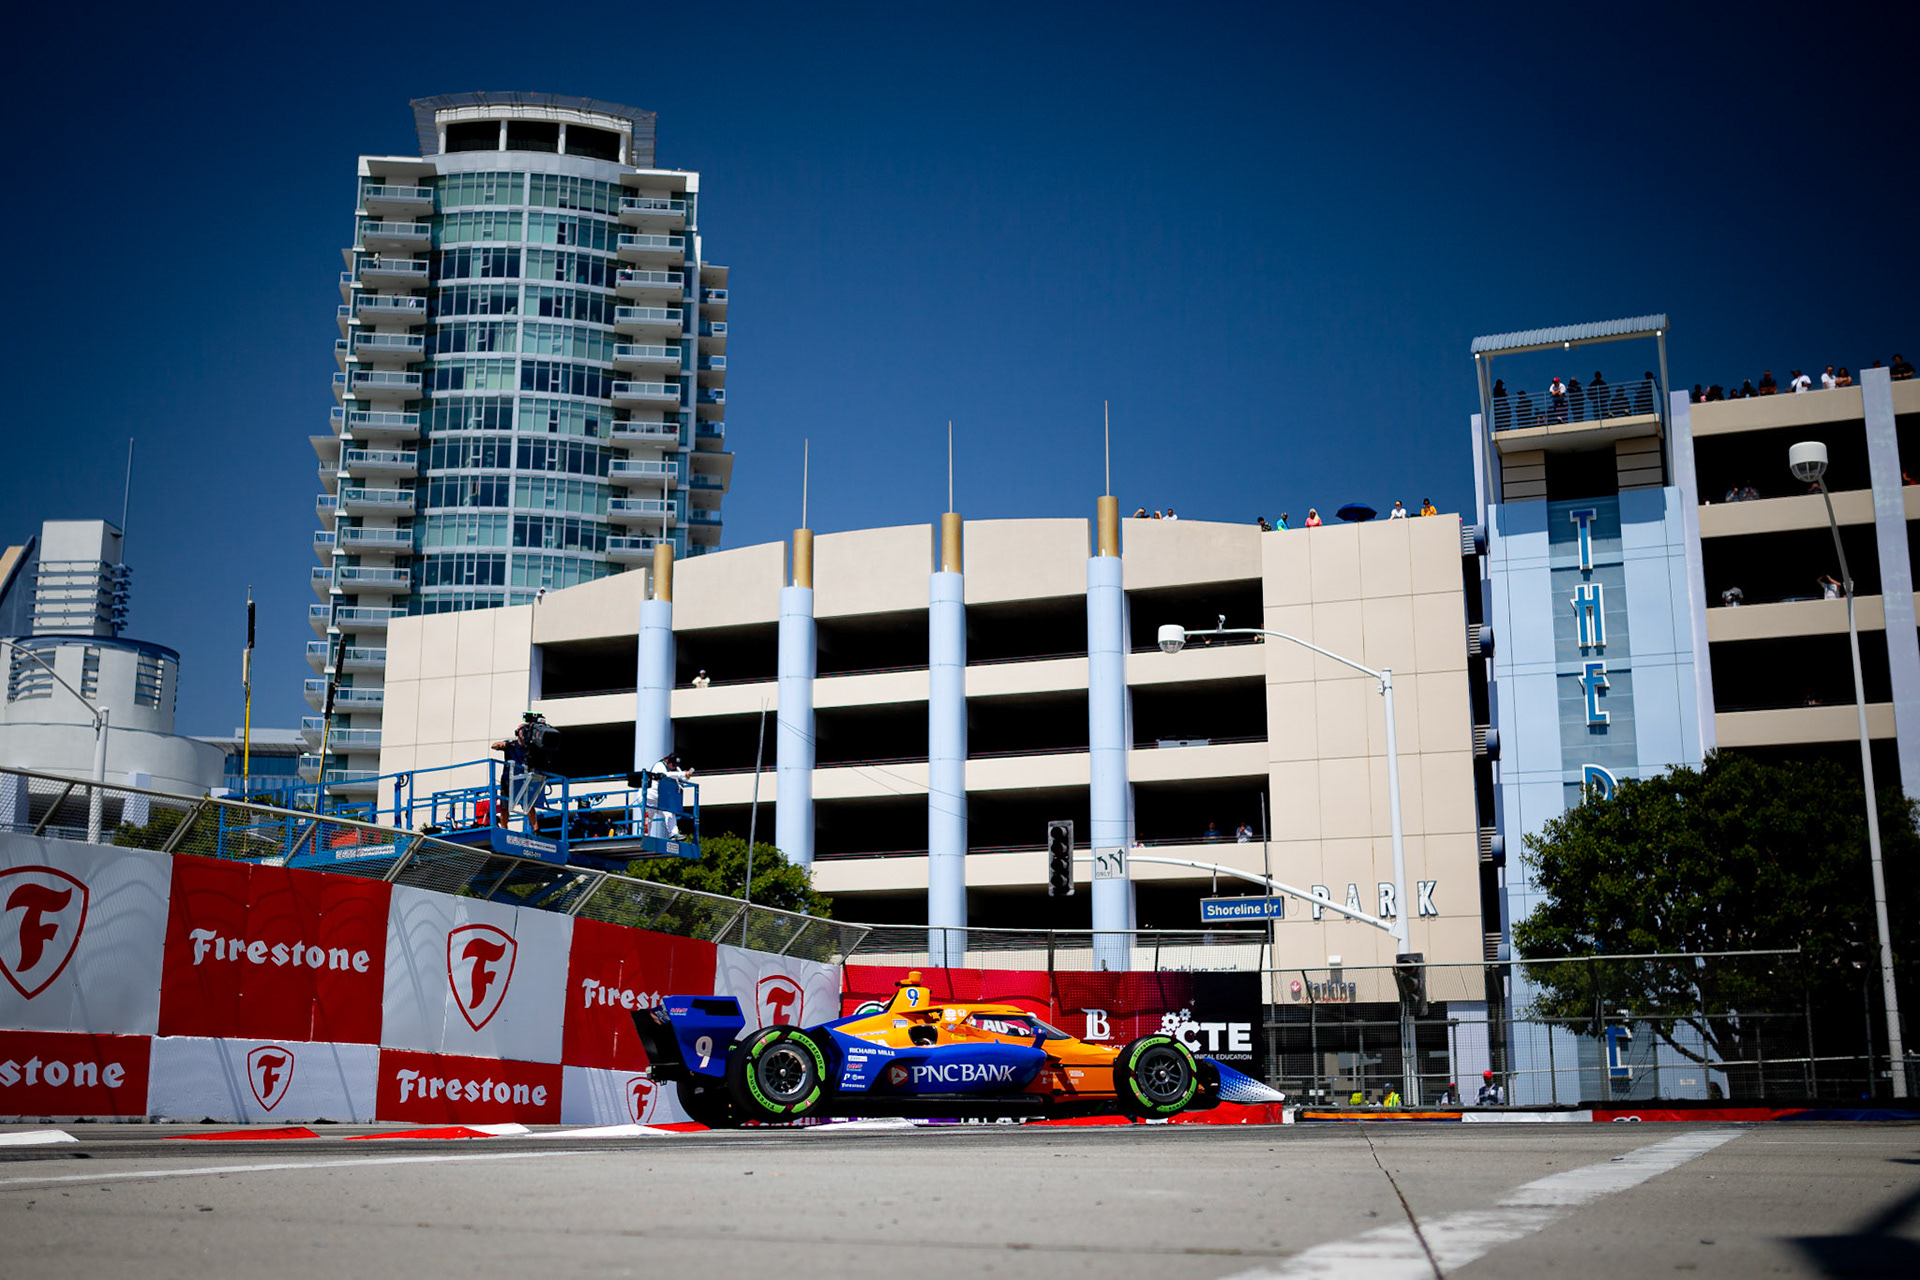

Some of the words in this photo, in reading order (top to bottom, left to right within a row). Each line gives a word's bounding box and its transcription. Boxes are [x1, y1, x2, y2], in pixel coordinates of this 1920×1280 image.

[1207, 904, 1261, 916] Shoreline
[1264, 903, 1279, 915] Dr
[1311, 881, 1439, 920] PARK
[189, 928, 371, 974] Firestone
[582, 978, 668, 1011] Firest
[907, 988, 919, 1007] 9
[695, 1035, 713, 1069] 9
[798, 1034, 824, 1070] Firestone
[849, 1047, 876, 1055] RICHARD
[1133, 1038, 1160, 1058] Firestone
[1175, 1020, 1252, 1053] CTE
[396, 1068, 547, 1107] Firestone
